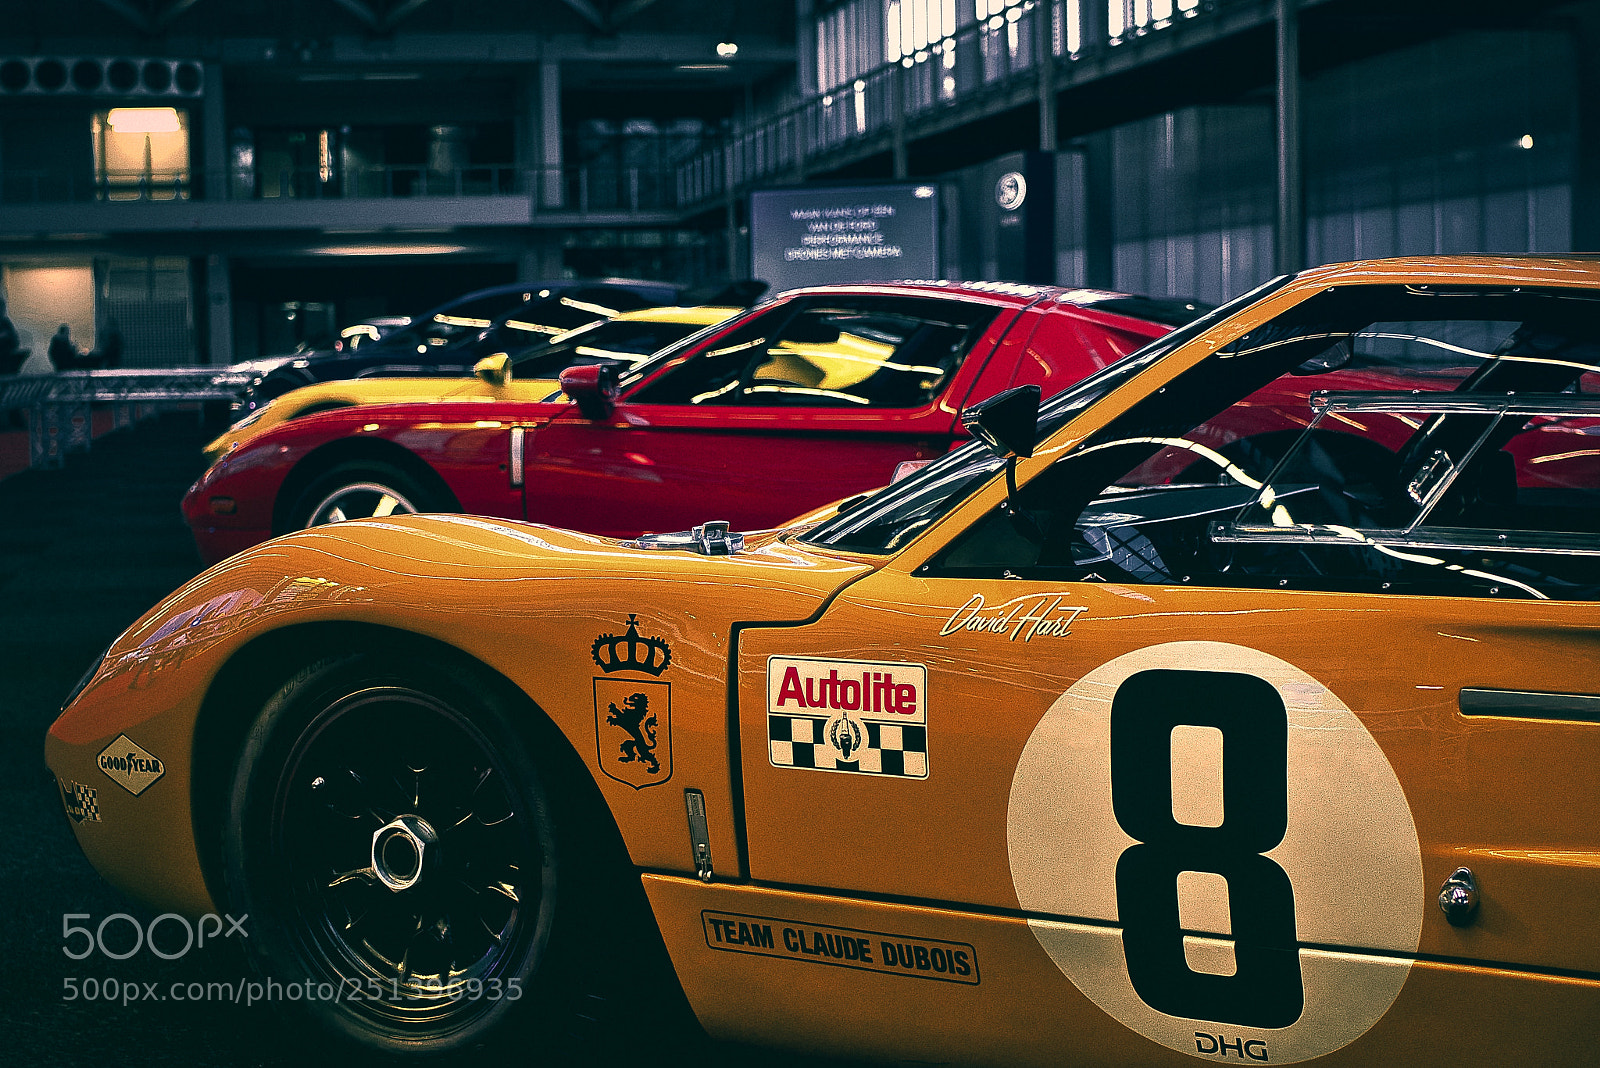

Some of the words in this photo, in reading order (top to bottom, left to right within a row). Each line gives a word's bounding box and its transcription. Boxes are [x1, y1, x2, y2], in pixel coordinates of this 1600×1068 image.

[939, 593, 1024, 636] David
[1009, 596, 1089, 642] Hart
[777, 666, 917, 715] Autolite
[100, 753, 161, 775] GOODYEAR
[1111, 669, 1305, 1030] 8
[708, 917, 775, 949] TEAM
[783, 927, 873, 964] CLAUDE
[880, 941, 971, 976] DUBOIS
[1194, 1031, 1269, 1062] DHG
